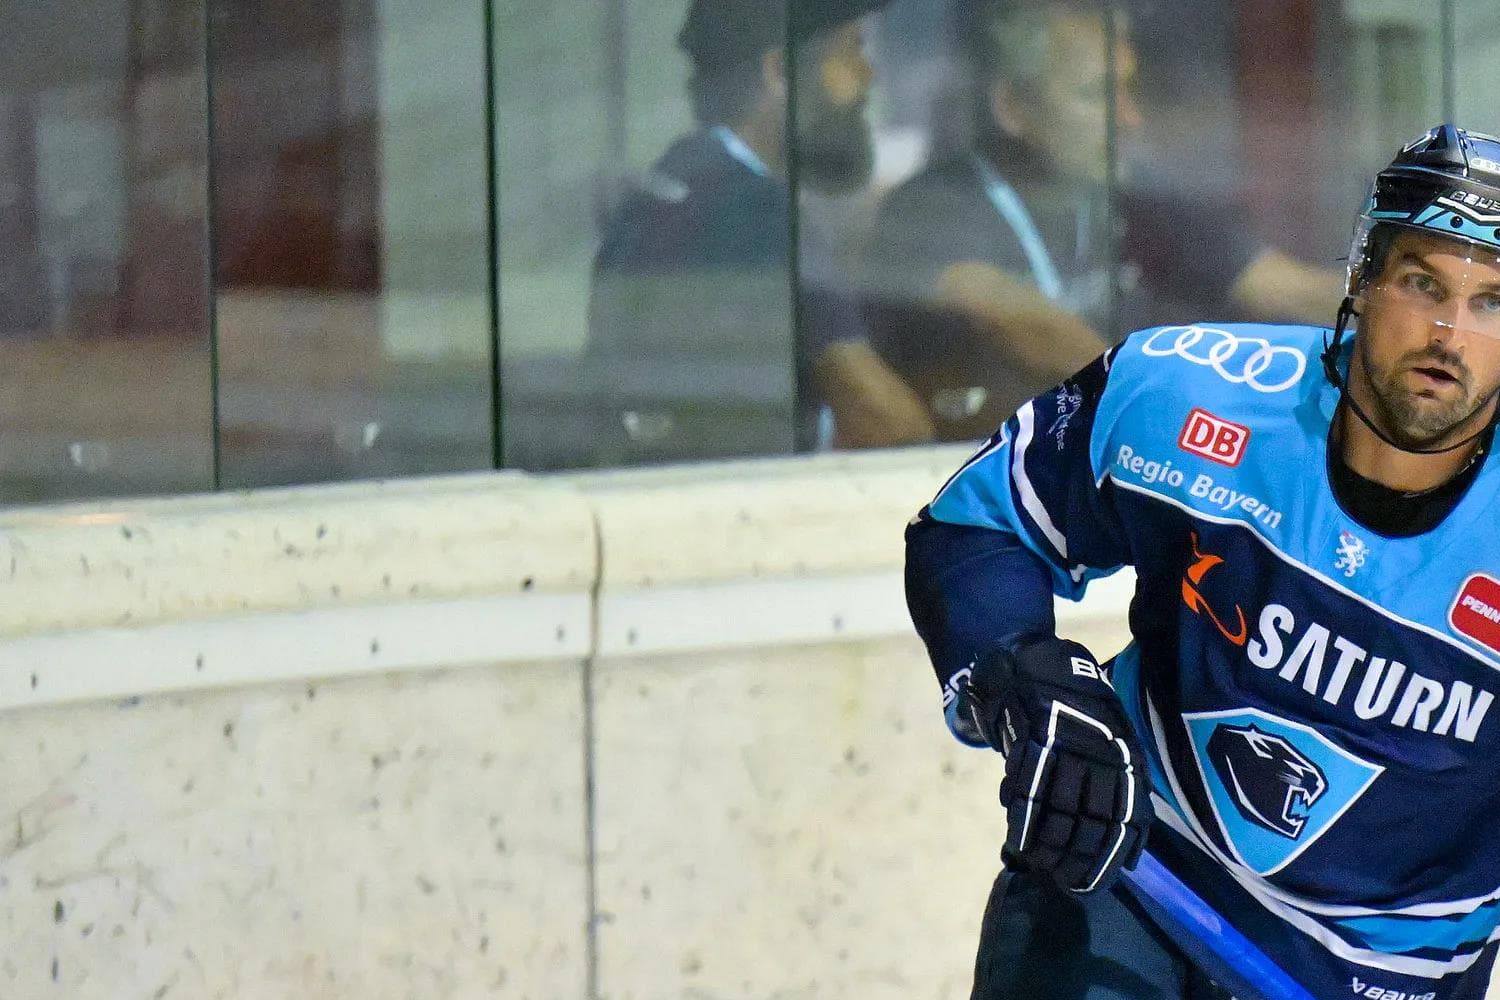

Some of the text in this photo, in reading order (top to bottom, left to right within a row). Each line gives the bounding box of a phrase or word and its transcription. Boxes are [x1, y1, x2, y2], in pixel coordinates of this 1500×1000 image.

[1187, 416, 1239, 457] DB
[1116, 444, 1283, 529] Regio Bayern
[1247, 604, 1495, 743] SATURN
